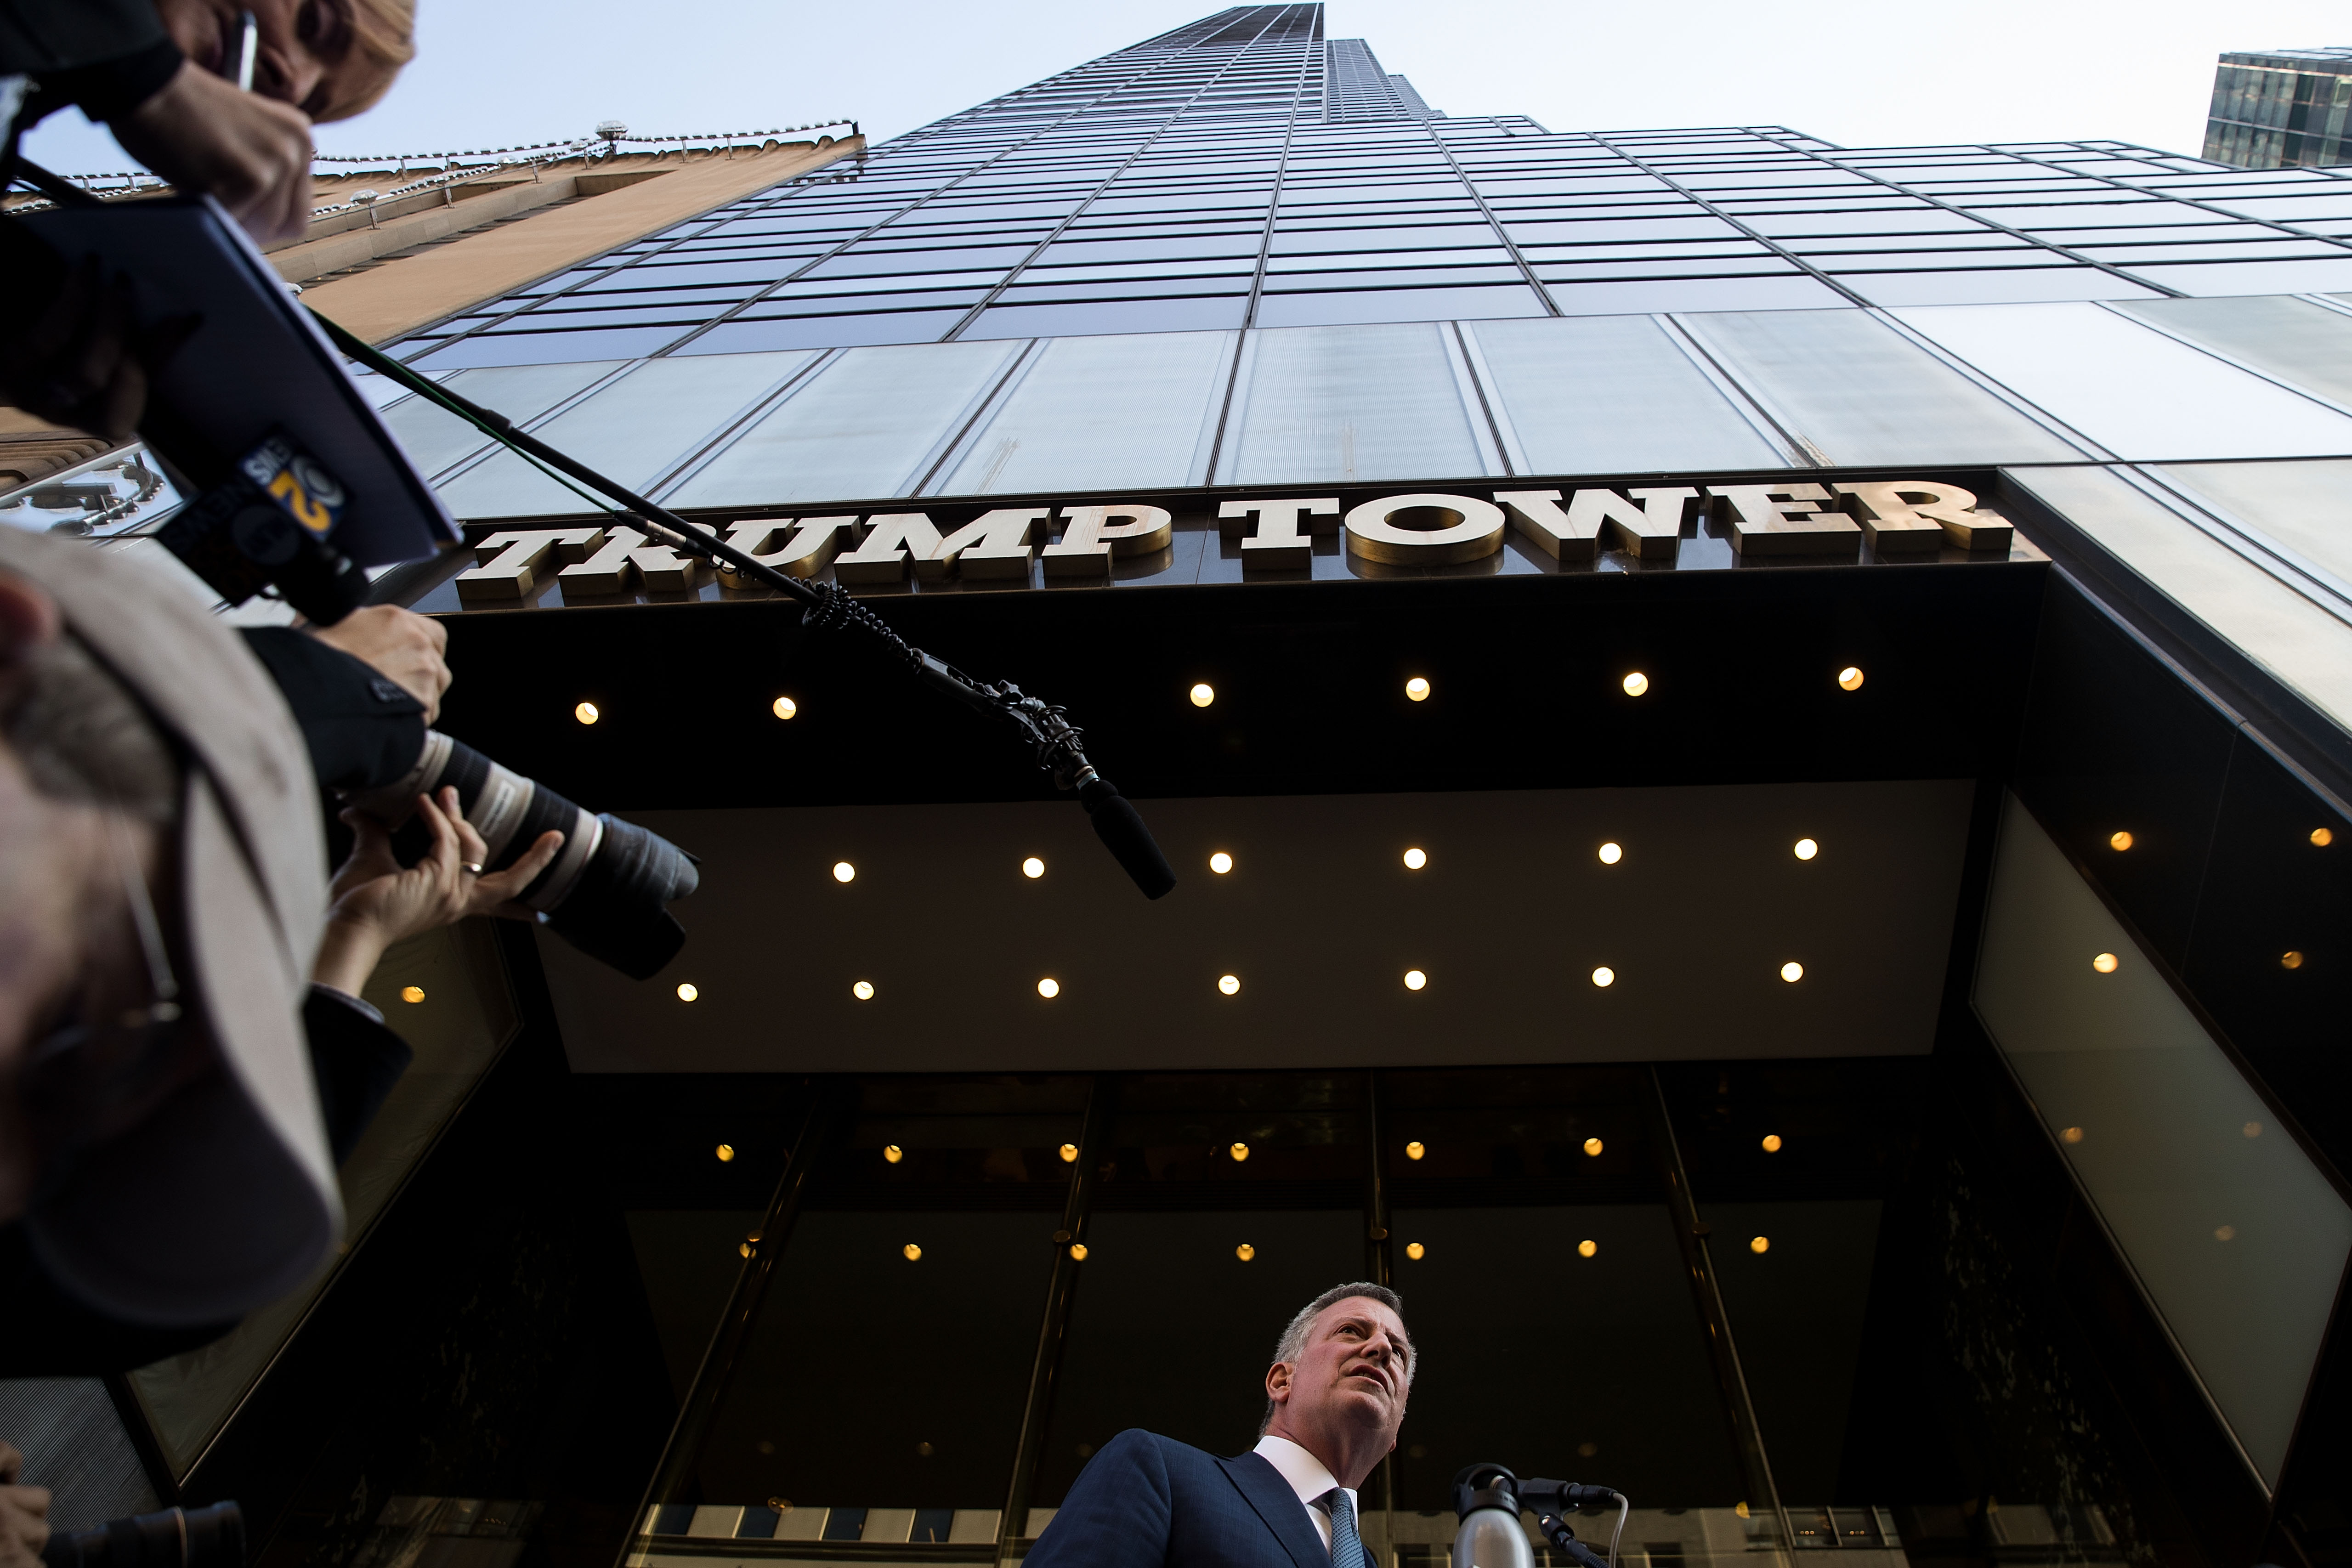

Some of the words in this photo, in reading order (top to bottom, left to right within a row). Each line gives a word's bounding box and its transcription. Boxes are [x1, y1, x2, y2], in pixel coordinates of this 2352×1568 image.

[268, 470, 332, 532] 2
[456, 504, 1173, 599] TRUMP
[1218, 480, 2015, 569] TOWER
